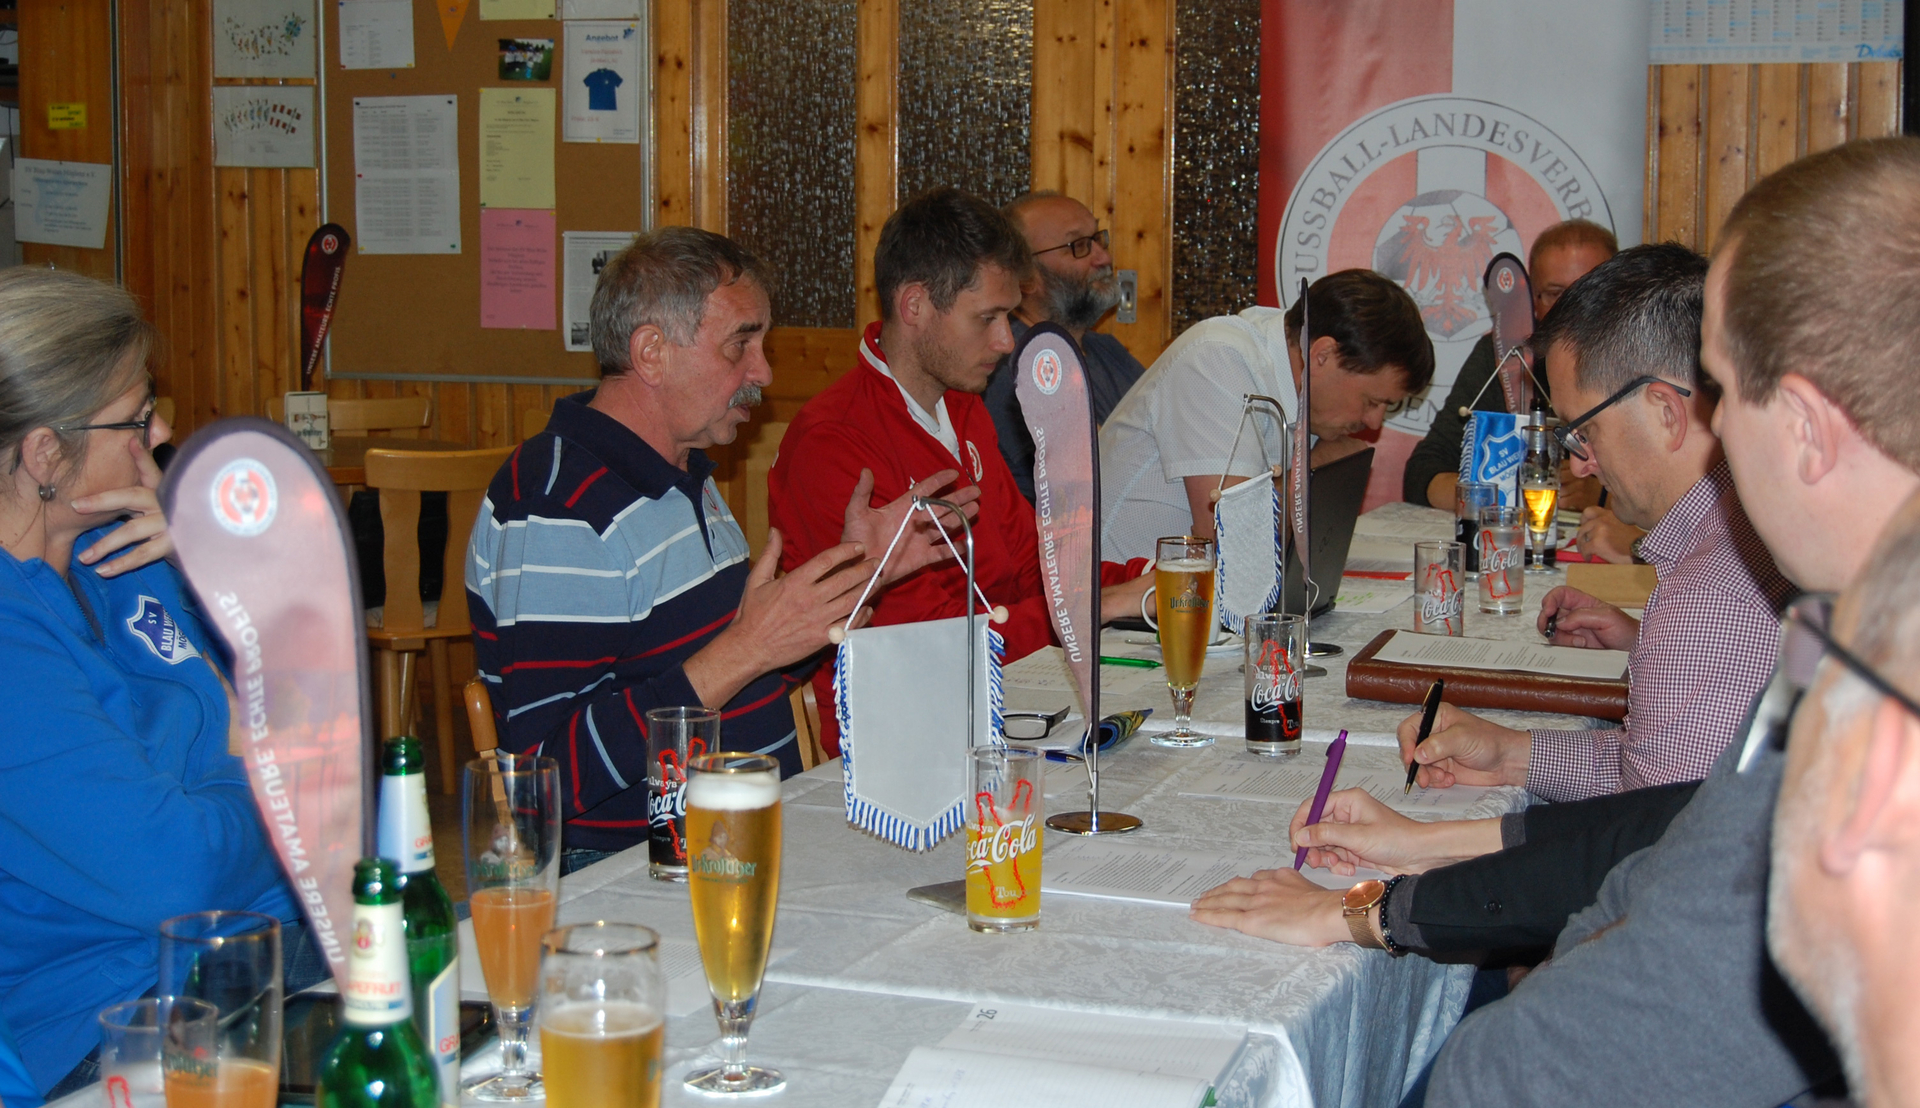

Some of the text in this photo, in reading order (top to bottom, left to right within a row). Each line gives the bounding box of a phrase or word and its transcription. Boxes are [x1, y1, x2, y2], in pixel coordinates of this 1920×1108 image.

[585, 34, 619, 43] Angebot
[1295, 112, 1593, 296] USSBALL-LANDESVERB
[1498, 447, 1510, 458] SV
[1488, 458, 1508, 474] BLAU
[1480, 545, 1518, 573] a-Cola
[148, 611, 158, 625] SV
[1421, 587, 1464, 625] Coca-C
[161, 628, 175, 652] BLAU
[647, 782, 688, 826] Coca-C
[966, 812, 1037, 872] ca-Cola
[976, 1008, 998, 1021] 26
